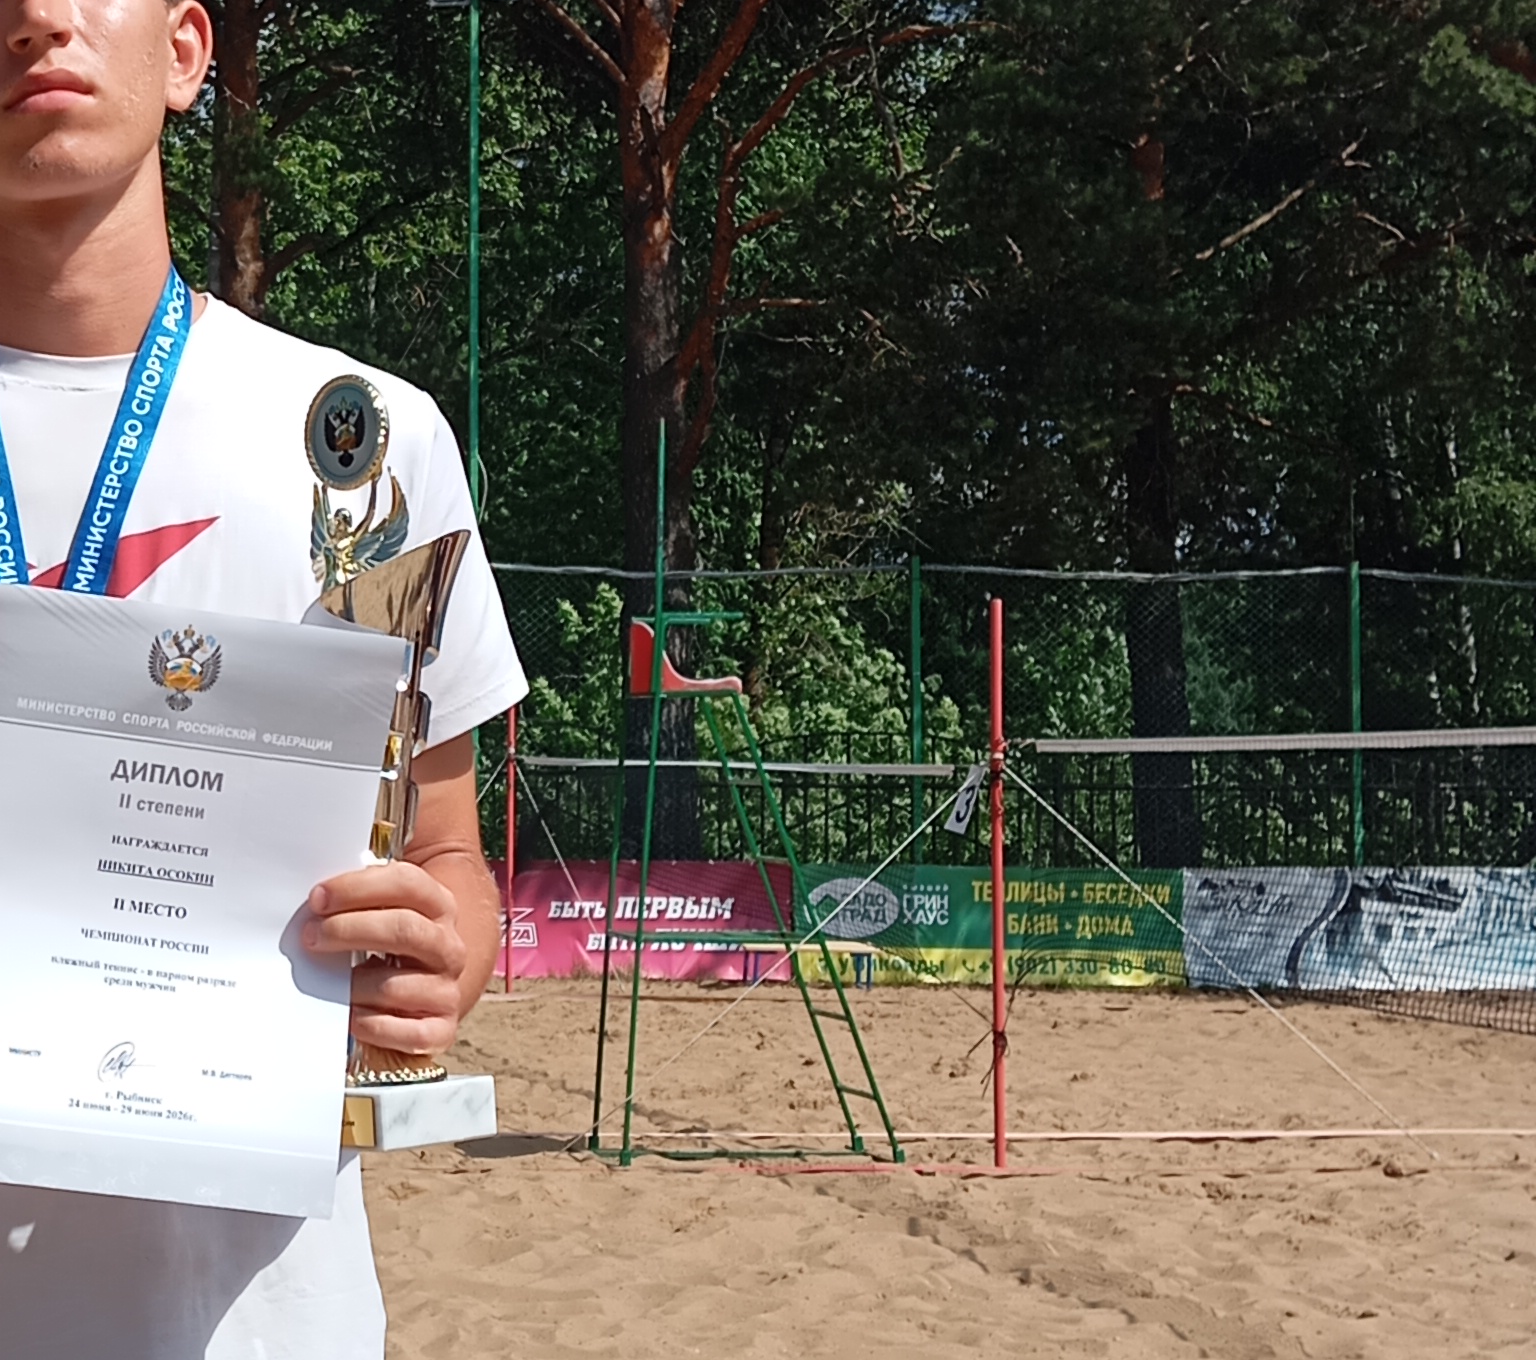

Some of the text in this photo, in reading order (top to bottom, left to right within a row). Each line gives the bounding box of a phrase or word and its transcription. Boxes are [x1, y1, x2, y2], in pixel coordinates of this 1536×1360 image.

[73, 419, 143, 592] МИНИСТЕРСТВО
[131, 335, 175, 415] СПОРТА
[16, 696, 333, 752] МИНИСТЕРСТВО СПОРТА РОССИЙСКОЙ ФЕДЕРАЦИИ
[110, 758, 224, 793] ДИПЛОМ
[136, 798, 205, 820] степени
[955, 785, 976, 824] 3
[111, 834, 209, 858] НАГРАЖДАЕТСЯ
[98, 858, 215, 886] НИКИТА ОСОКИН
[903, 894, 949, 910] ГРИН
[972, 880, 1065, 907] ТЕЛИЦЫ
[129, 900, 188, 920] МЕСТО
[547, 896, 734, 920] БЫТЬ ПЕРВЫМ
[903, 909, 949, 926] ХАУС
[81, 927, 210, 955] ЧЕМПИОНАТ РОССИИ
